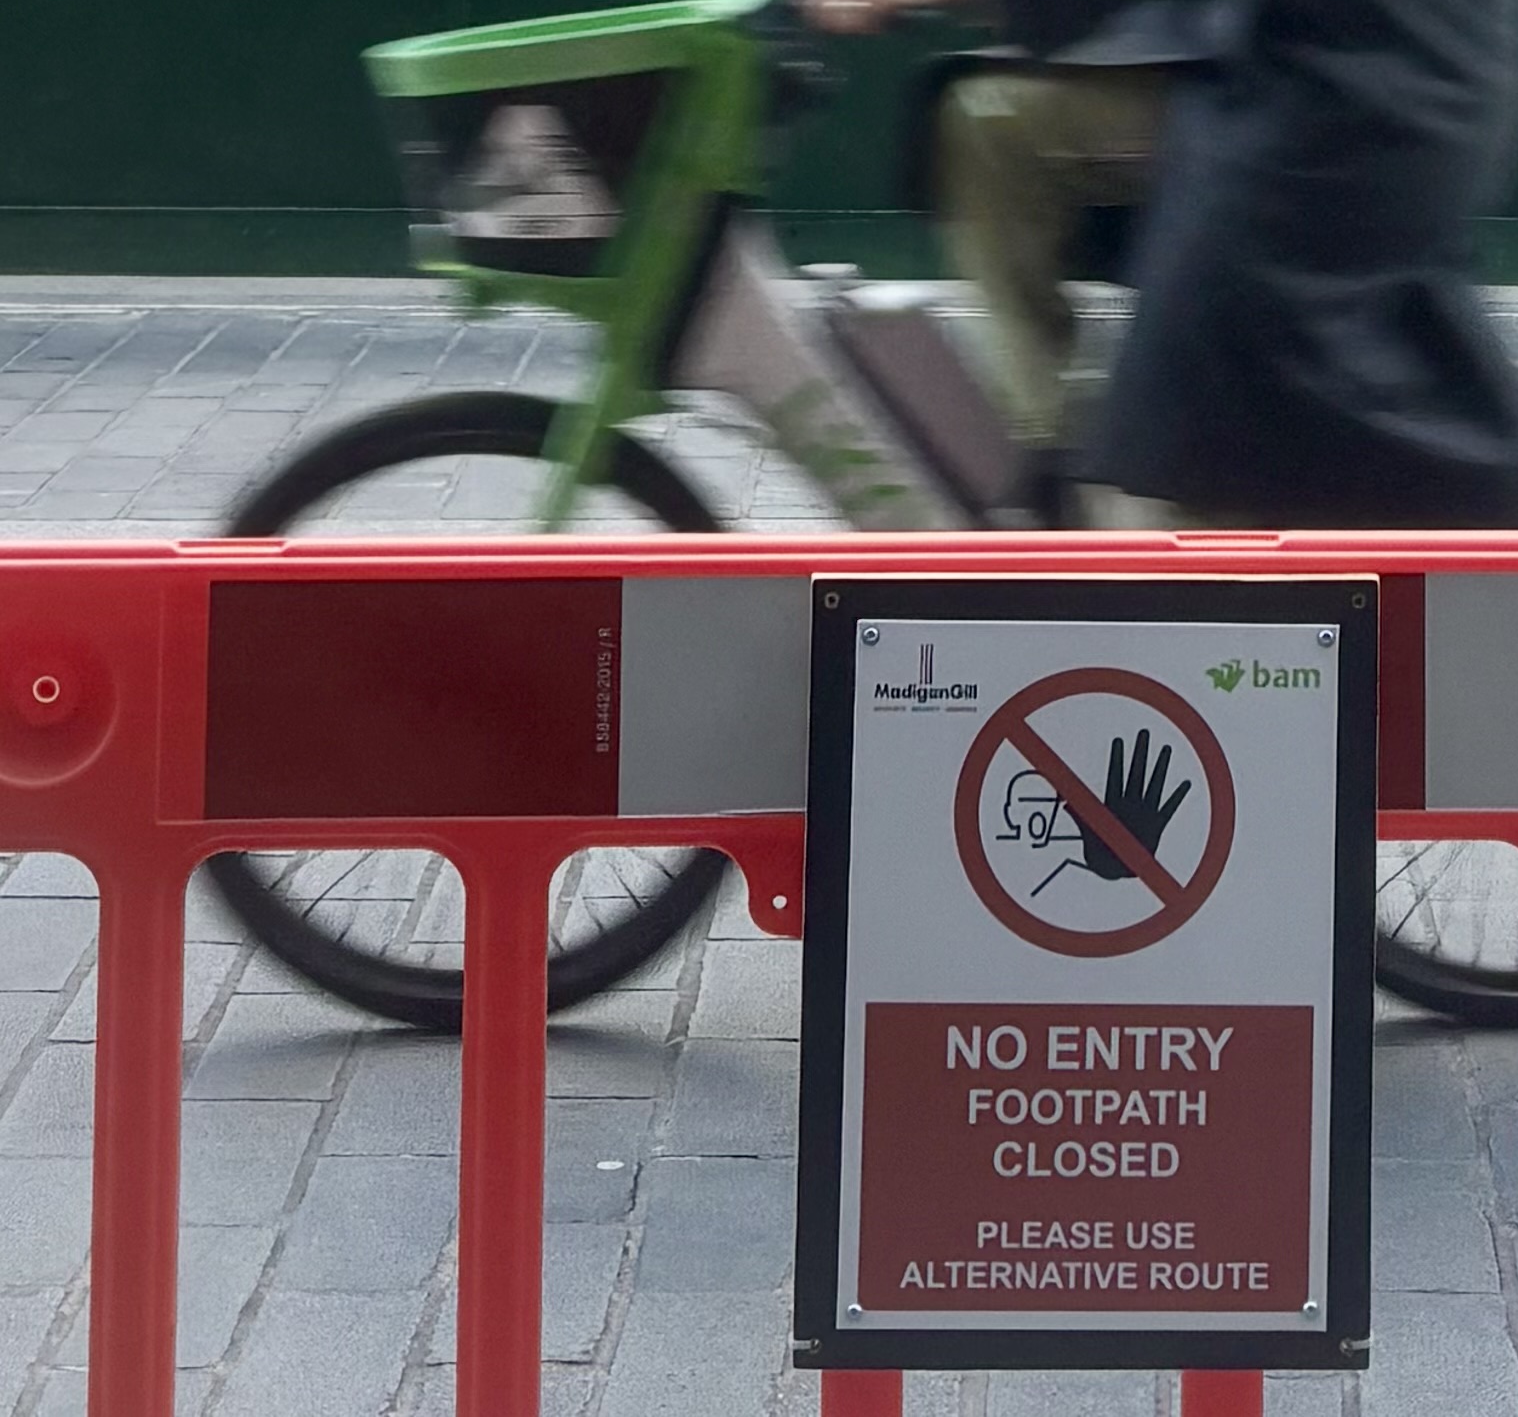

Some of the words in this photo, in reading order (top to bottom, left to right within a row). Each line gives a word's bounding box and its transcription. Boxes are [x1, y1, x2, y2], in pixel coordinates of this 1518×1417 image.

[1252, 659, 1321, 689] bam
[873, 683, 978, 704] MadiganGill
[946, 1025, 1028, 1070] NO
[1047, 1026, 1234, 1071] ENTRY
[968, 1088, 1207, 1126] FOOTPATH
[993, 1140, 1180, 1178] CLOSED
[977, 1221, 1114, 1250] PLEASE
[1126, 1221, 1196, 1250] USE
[899, 1261, 1138, 1290] ALTERNATIVE
[1149, 1262, 1269, 1290] ROUTE
